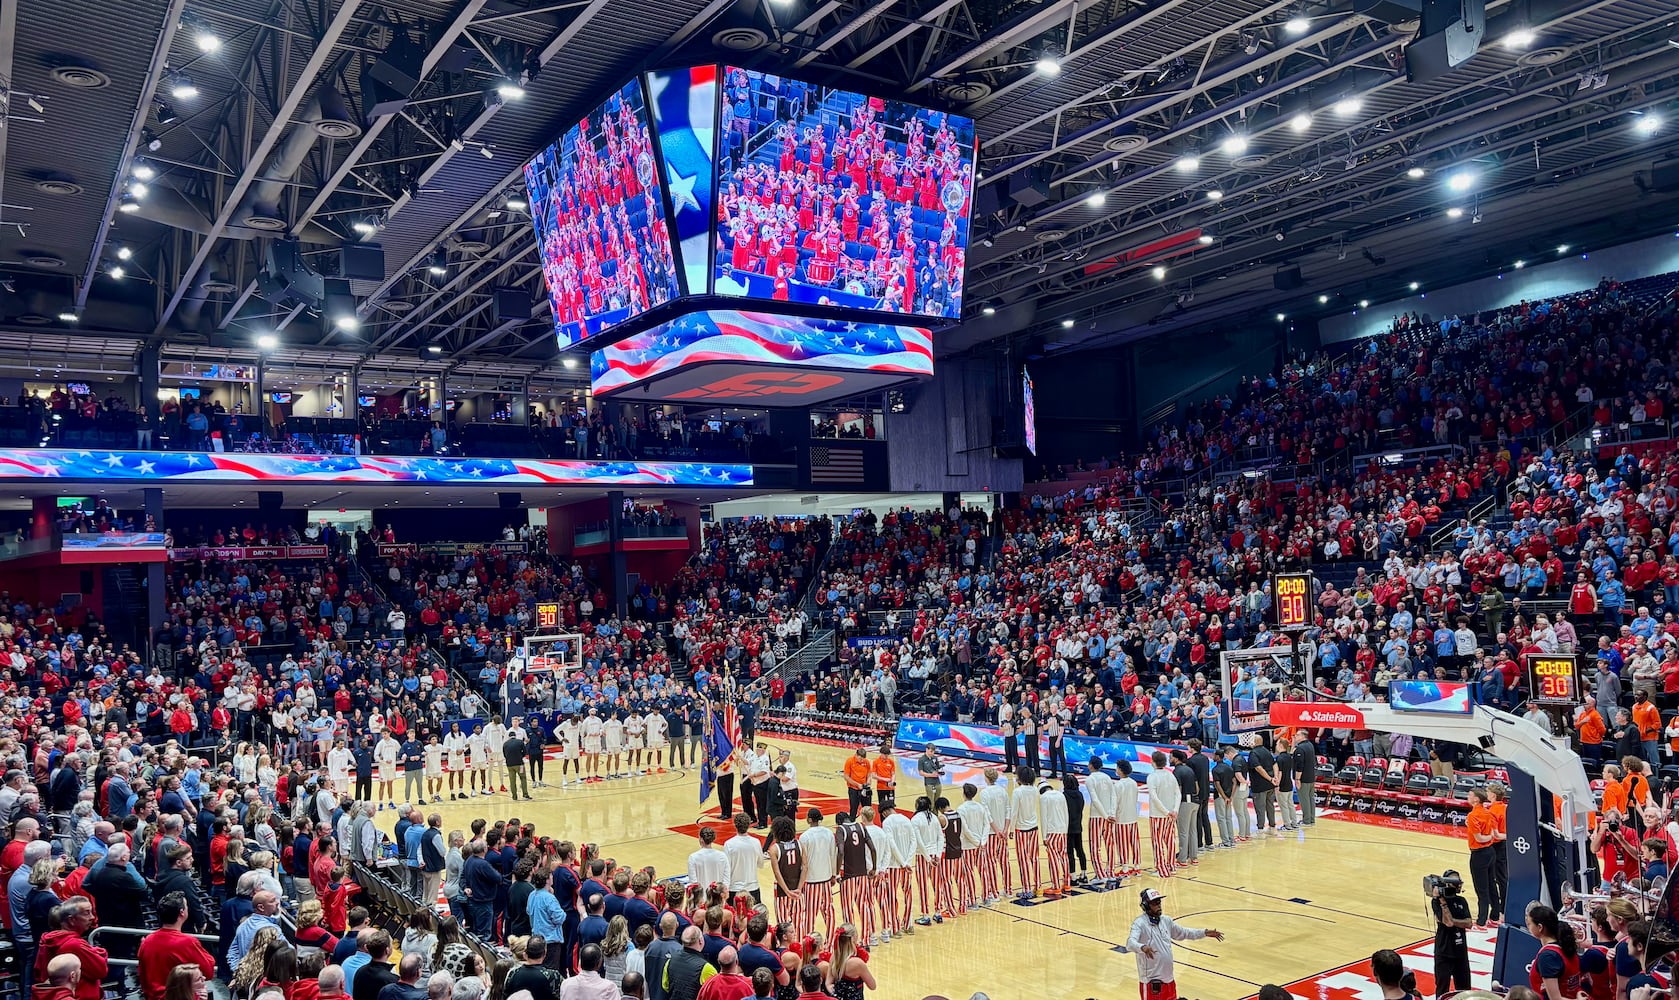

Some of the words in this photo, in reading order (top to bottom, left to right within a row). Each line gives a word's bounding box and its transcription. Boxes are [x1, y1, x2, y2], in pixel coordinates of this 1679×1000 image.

[1278, 578, 1306, 595] 20:00
[538, 605, 557, 613] 20:00
[1282, 595, 1305, 623] 30
[540, 613, 556, 626] 30
[1535, 660, 1573, 675] 20:00
[1543, 676, 1568, 695] 30
[1331, 795, 1349, 806] Kroger
[1354, 798, 1372, 810] Kroger
[1376, 801, 1395, 813] Kroger
[1398, 804, 1418, 816] Kroger
[1422, 807, 1443, 819] Kroger
[953, 820, 958, 833] 1
[852, 831, 860, 846] 9
[786, 849, 796, 865] 11
